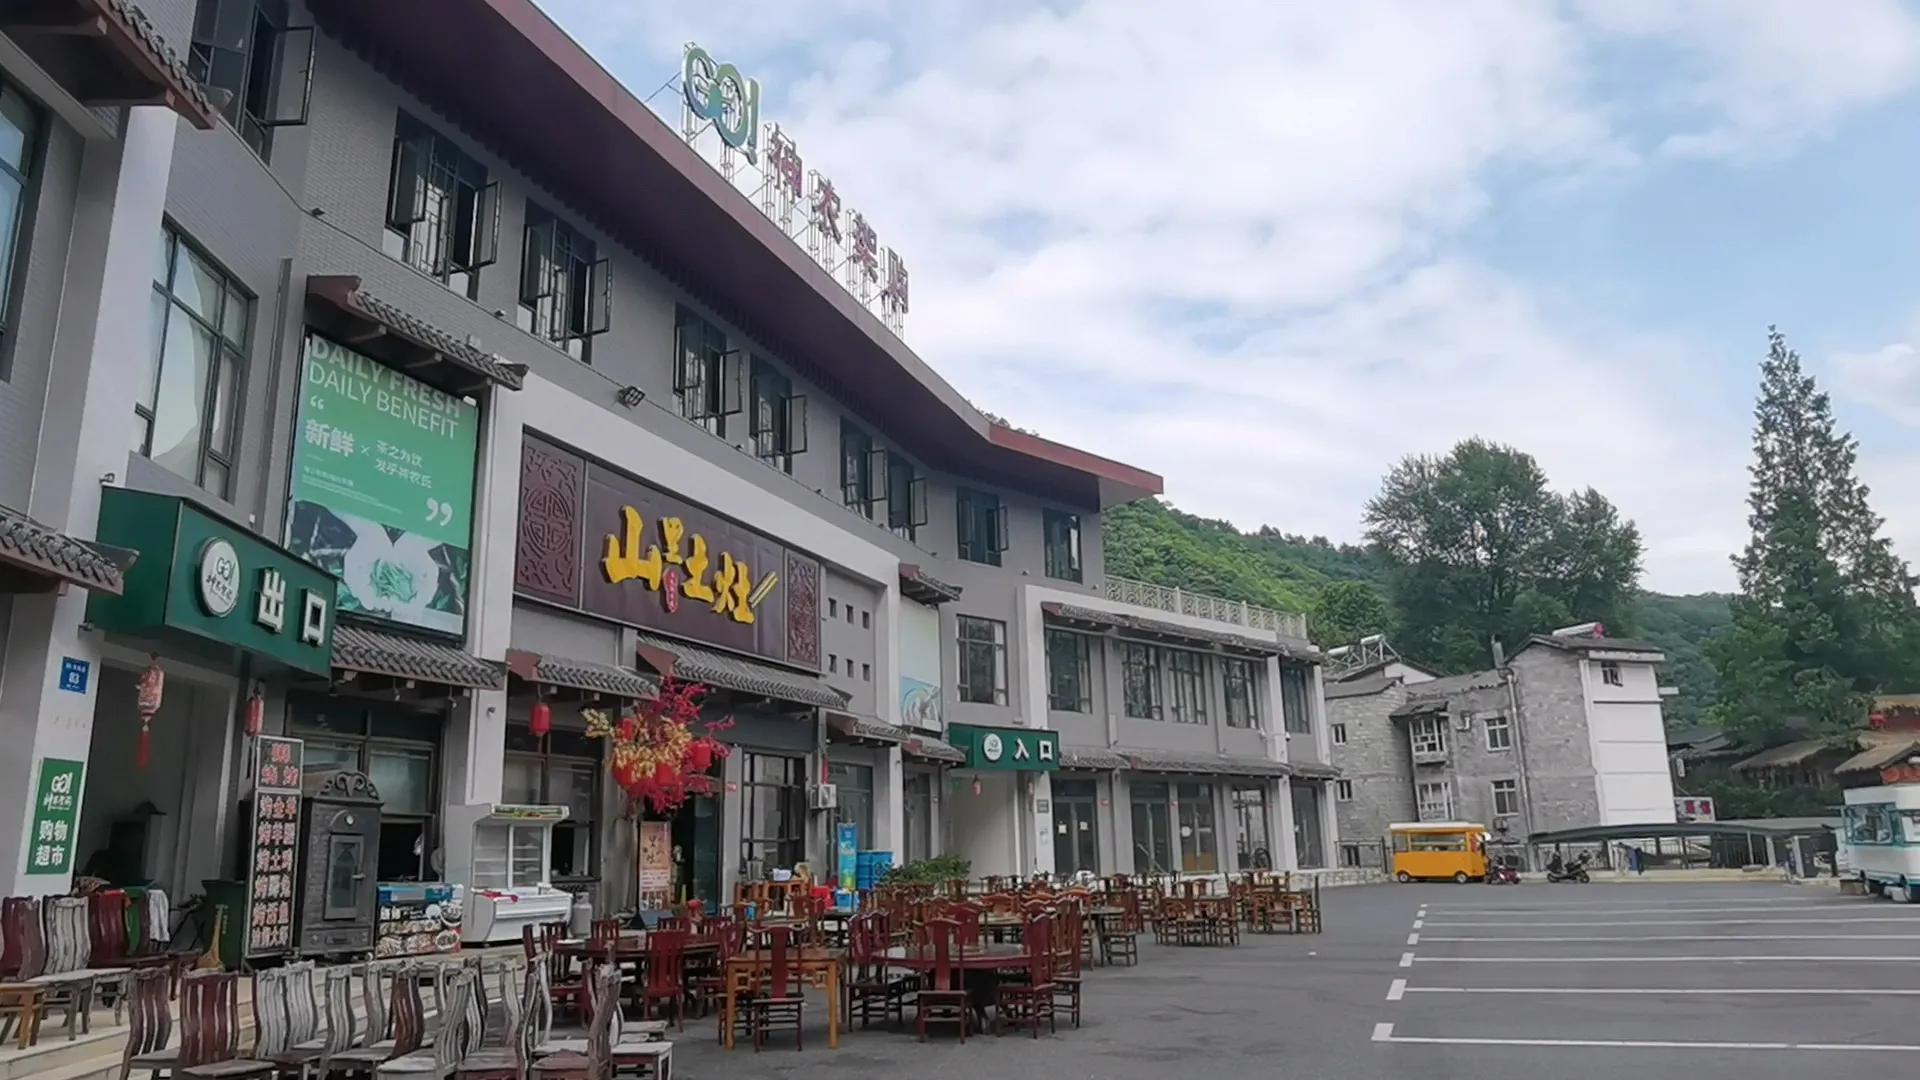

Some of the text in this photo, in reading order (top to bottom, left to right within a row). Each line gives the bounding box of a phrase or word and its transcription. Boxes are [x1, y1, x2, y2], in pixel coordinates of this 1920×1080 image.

[308, 362, 459, 440] DAILY BENEFIT
[389, 376, 460, 418] FRESH
[304, 418, 355, 458] 新鲜
[257, 567, 327, 647] 出口
[1013, 737, 1053, 761] 入口
[38, 819, 68, 842] 购物
[34, 845, 65, 866] 超市
